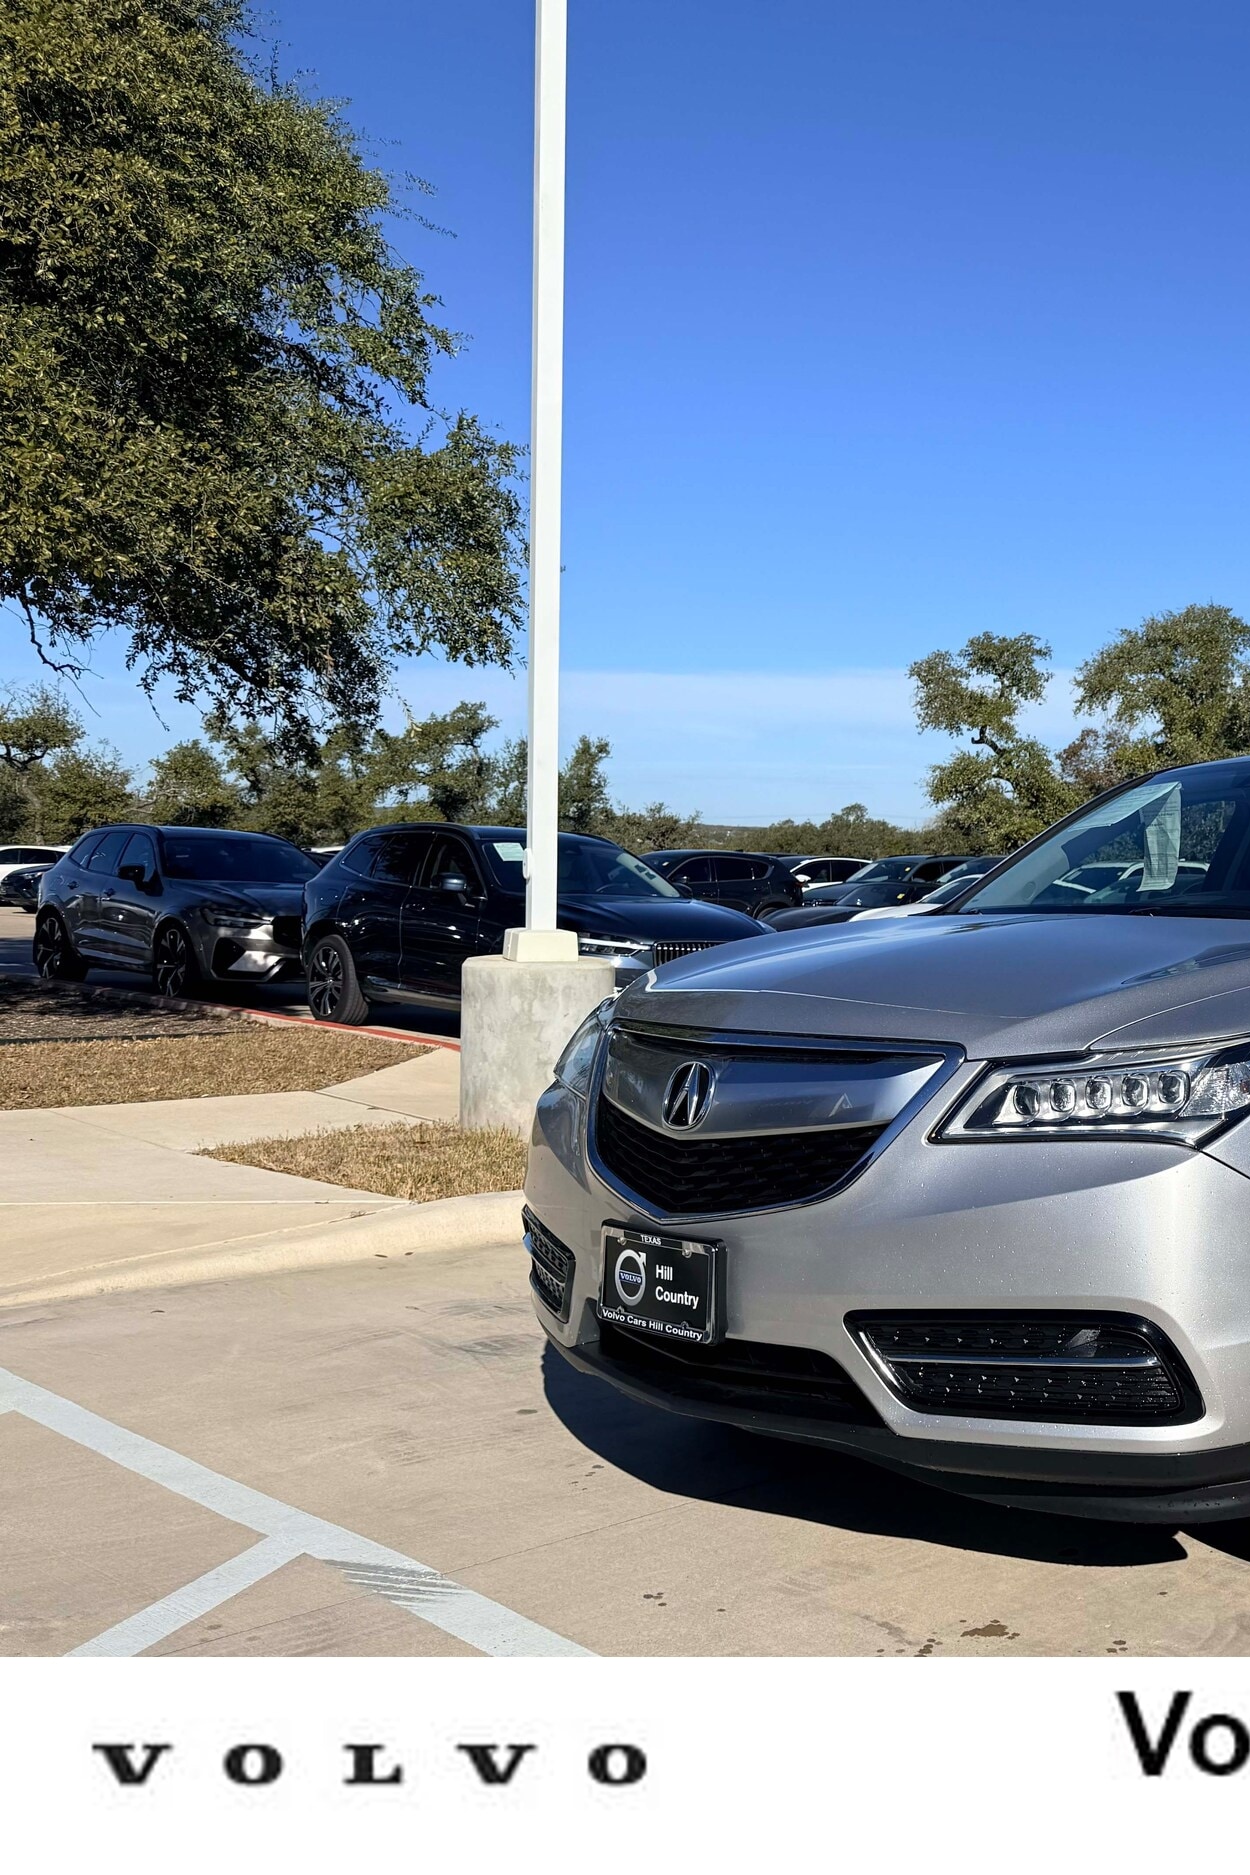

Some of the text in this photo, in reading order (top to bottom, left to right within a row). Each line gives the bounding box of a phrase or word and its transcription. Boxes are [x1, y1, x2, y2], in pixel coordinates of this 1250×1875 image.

[641, 1235, 661, 1245] TEXAS
[620, 1273, 642, 1283] VOLVO
[656, 1264, 673, 1281] Hill
[655, 1286, 699, 1309] Country
[602, 1309, 702, 1341] Volvo Cars Hill Country
